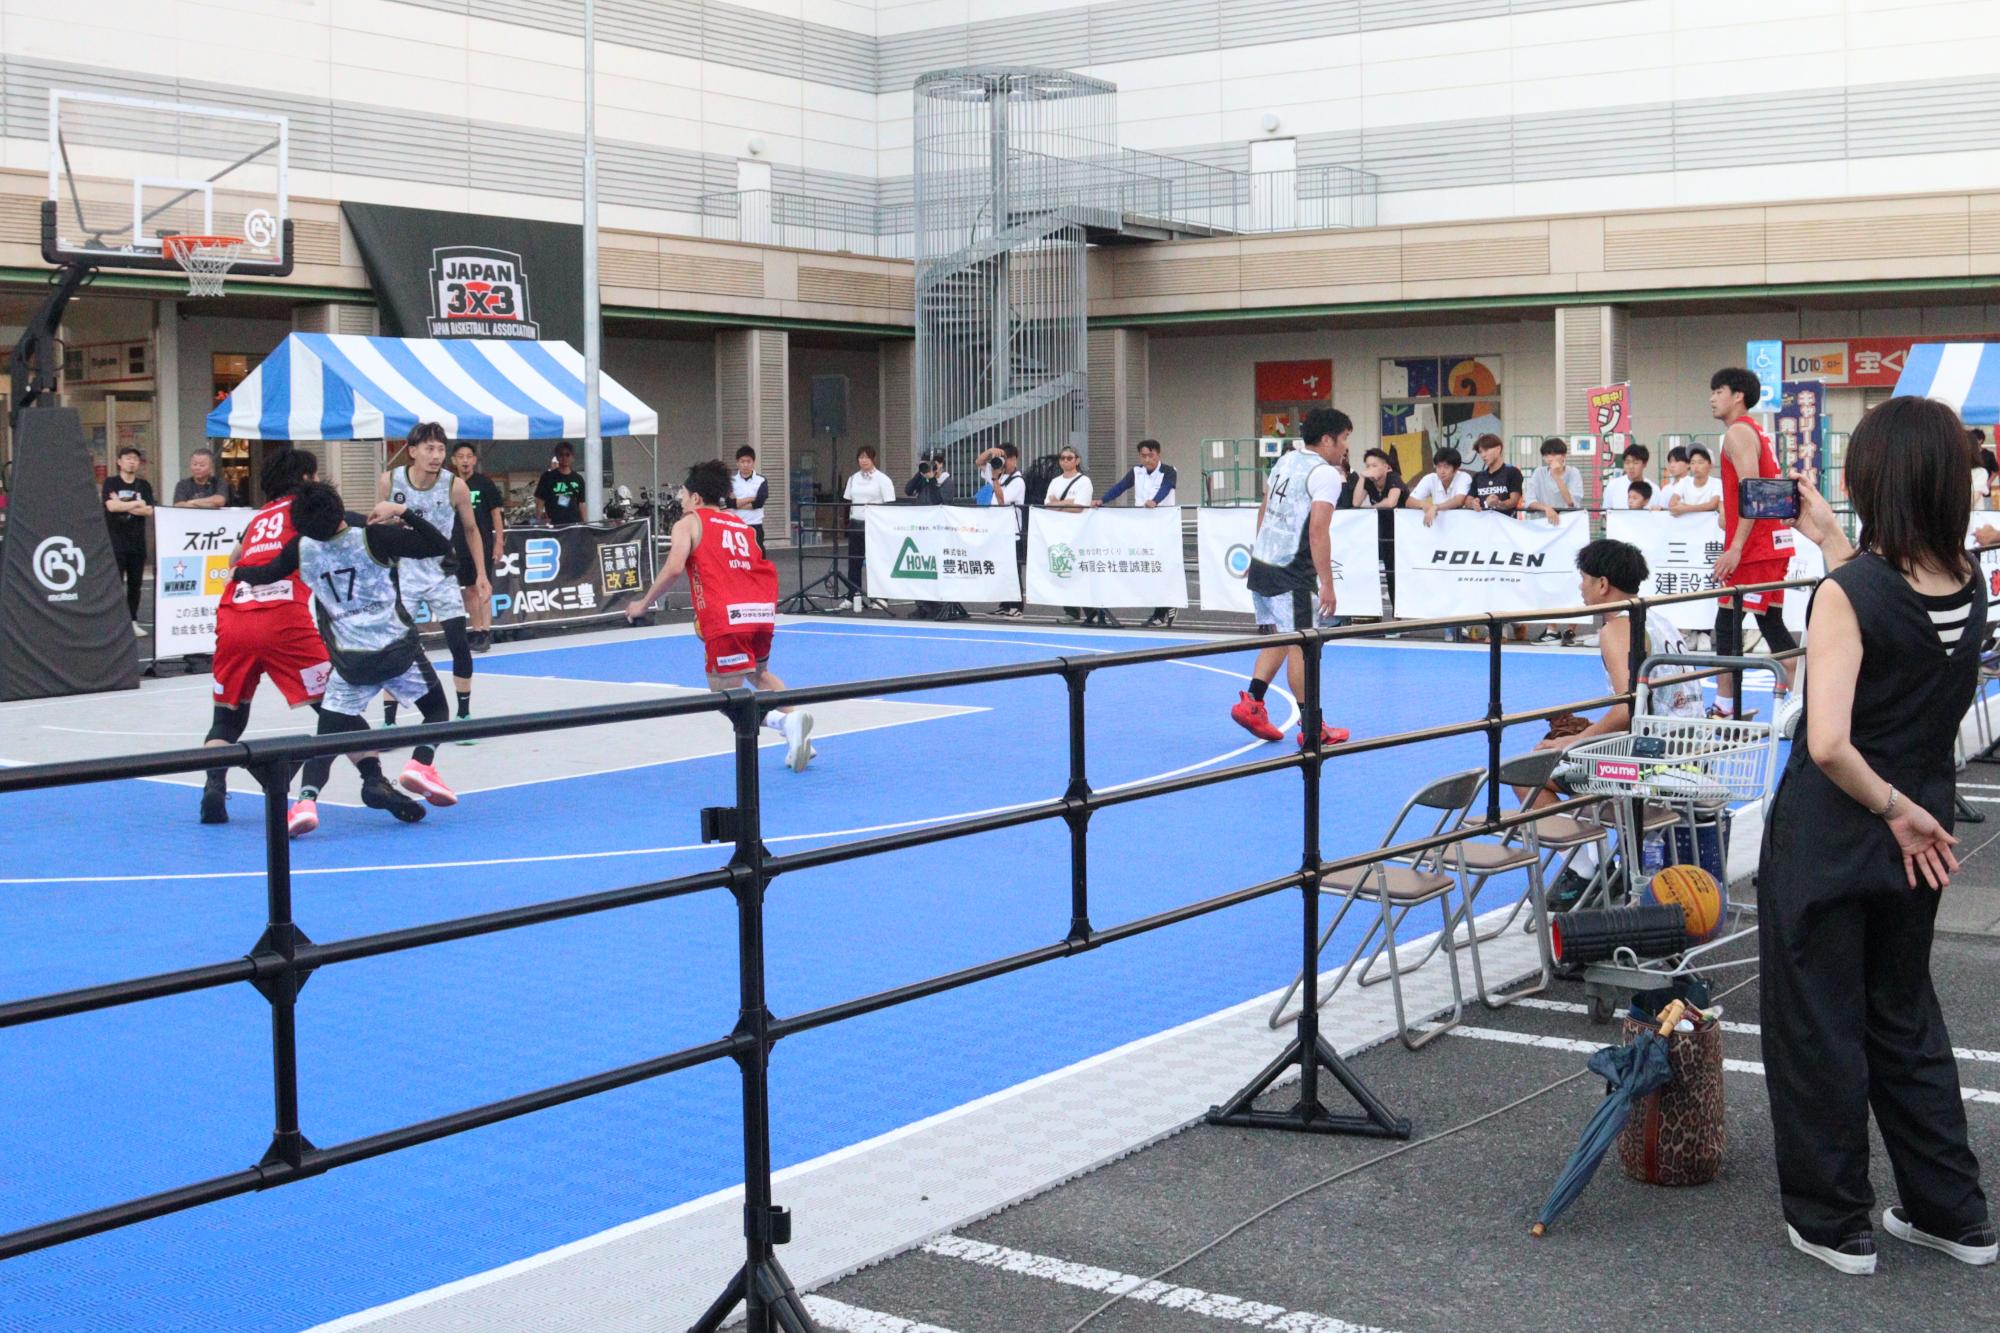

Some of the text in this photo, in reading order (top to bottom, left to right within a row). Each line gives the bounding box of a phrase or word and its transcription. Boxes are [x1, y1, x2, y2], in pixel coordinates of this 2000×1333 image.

[446, 262, 512, 282] JAPAN
[447, 283, 515, 315] 3x3
[432, 321, 536, 339] JAPAN BASKETBALL ASSOCIATION
[1790, 356, 1821, 375] LOTO
[1269, 473, 1290, 503] 14
[251, 512, 284, 544] 39
[722, 529, 750, 557] 49
[943, 548, 968, 557] 株式会社
[906, 554, 938, 571] HOWA
[943, 559, 996, 576] 豊和開発
[1078, 560, 1162, 573] 有限会社豊誠建設
[1431, 550, 1546, 568] POLLEN
[164, 580, 197, 592] WINNER
[320, 567, 356, 603] 17
[606, 570, 638, 590] 改革
